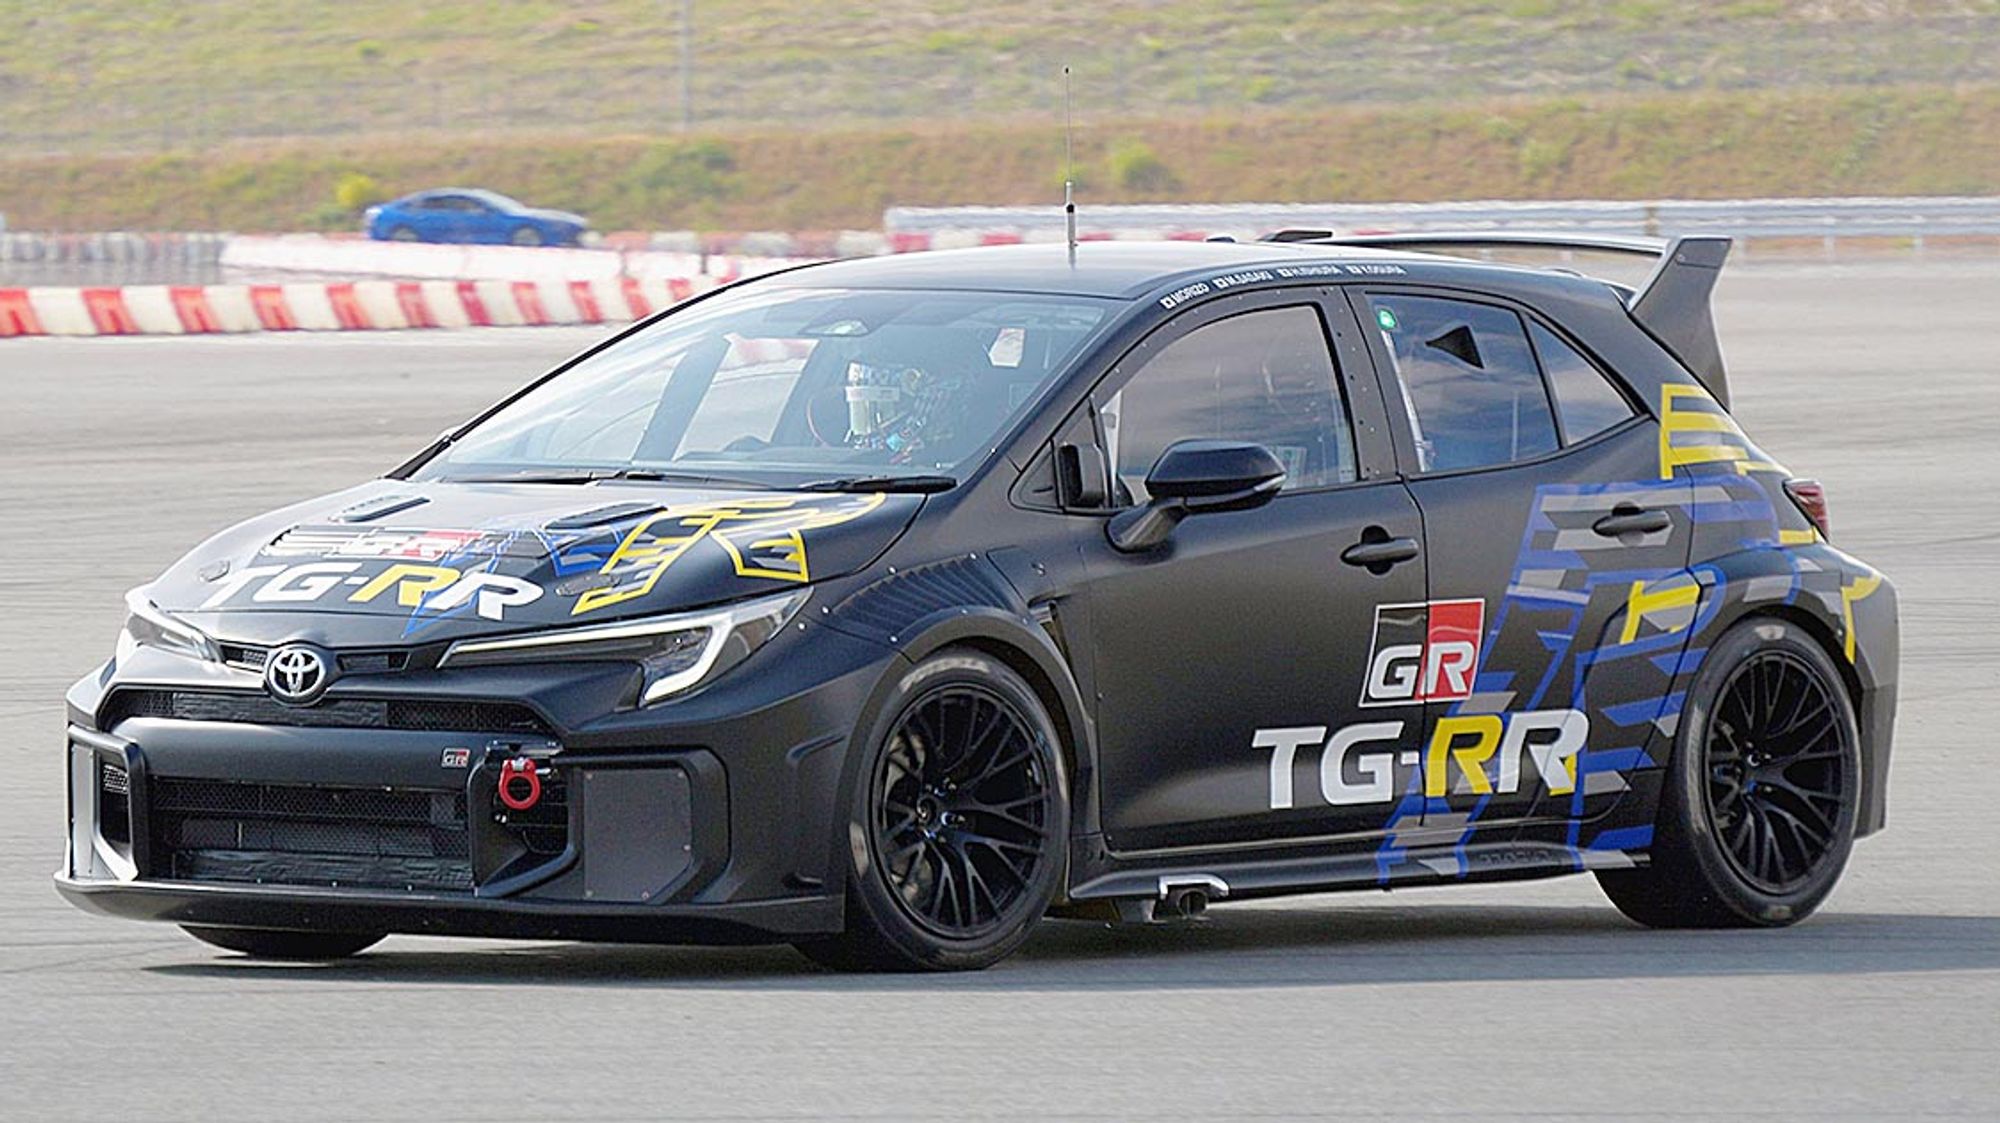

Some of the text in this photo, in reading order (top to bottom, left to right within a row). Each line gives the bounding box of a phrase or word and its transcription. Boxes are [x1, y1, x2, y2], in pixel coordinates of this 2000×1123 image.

[1171, 283, 1210, 304] MORIZO
[199, 562, 545, 621] TG-RR
[1368, 640, 1475, 698] GR
[1251, 709, 1590, 809] TG-RR
